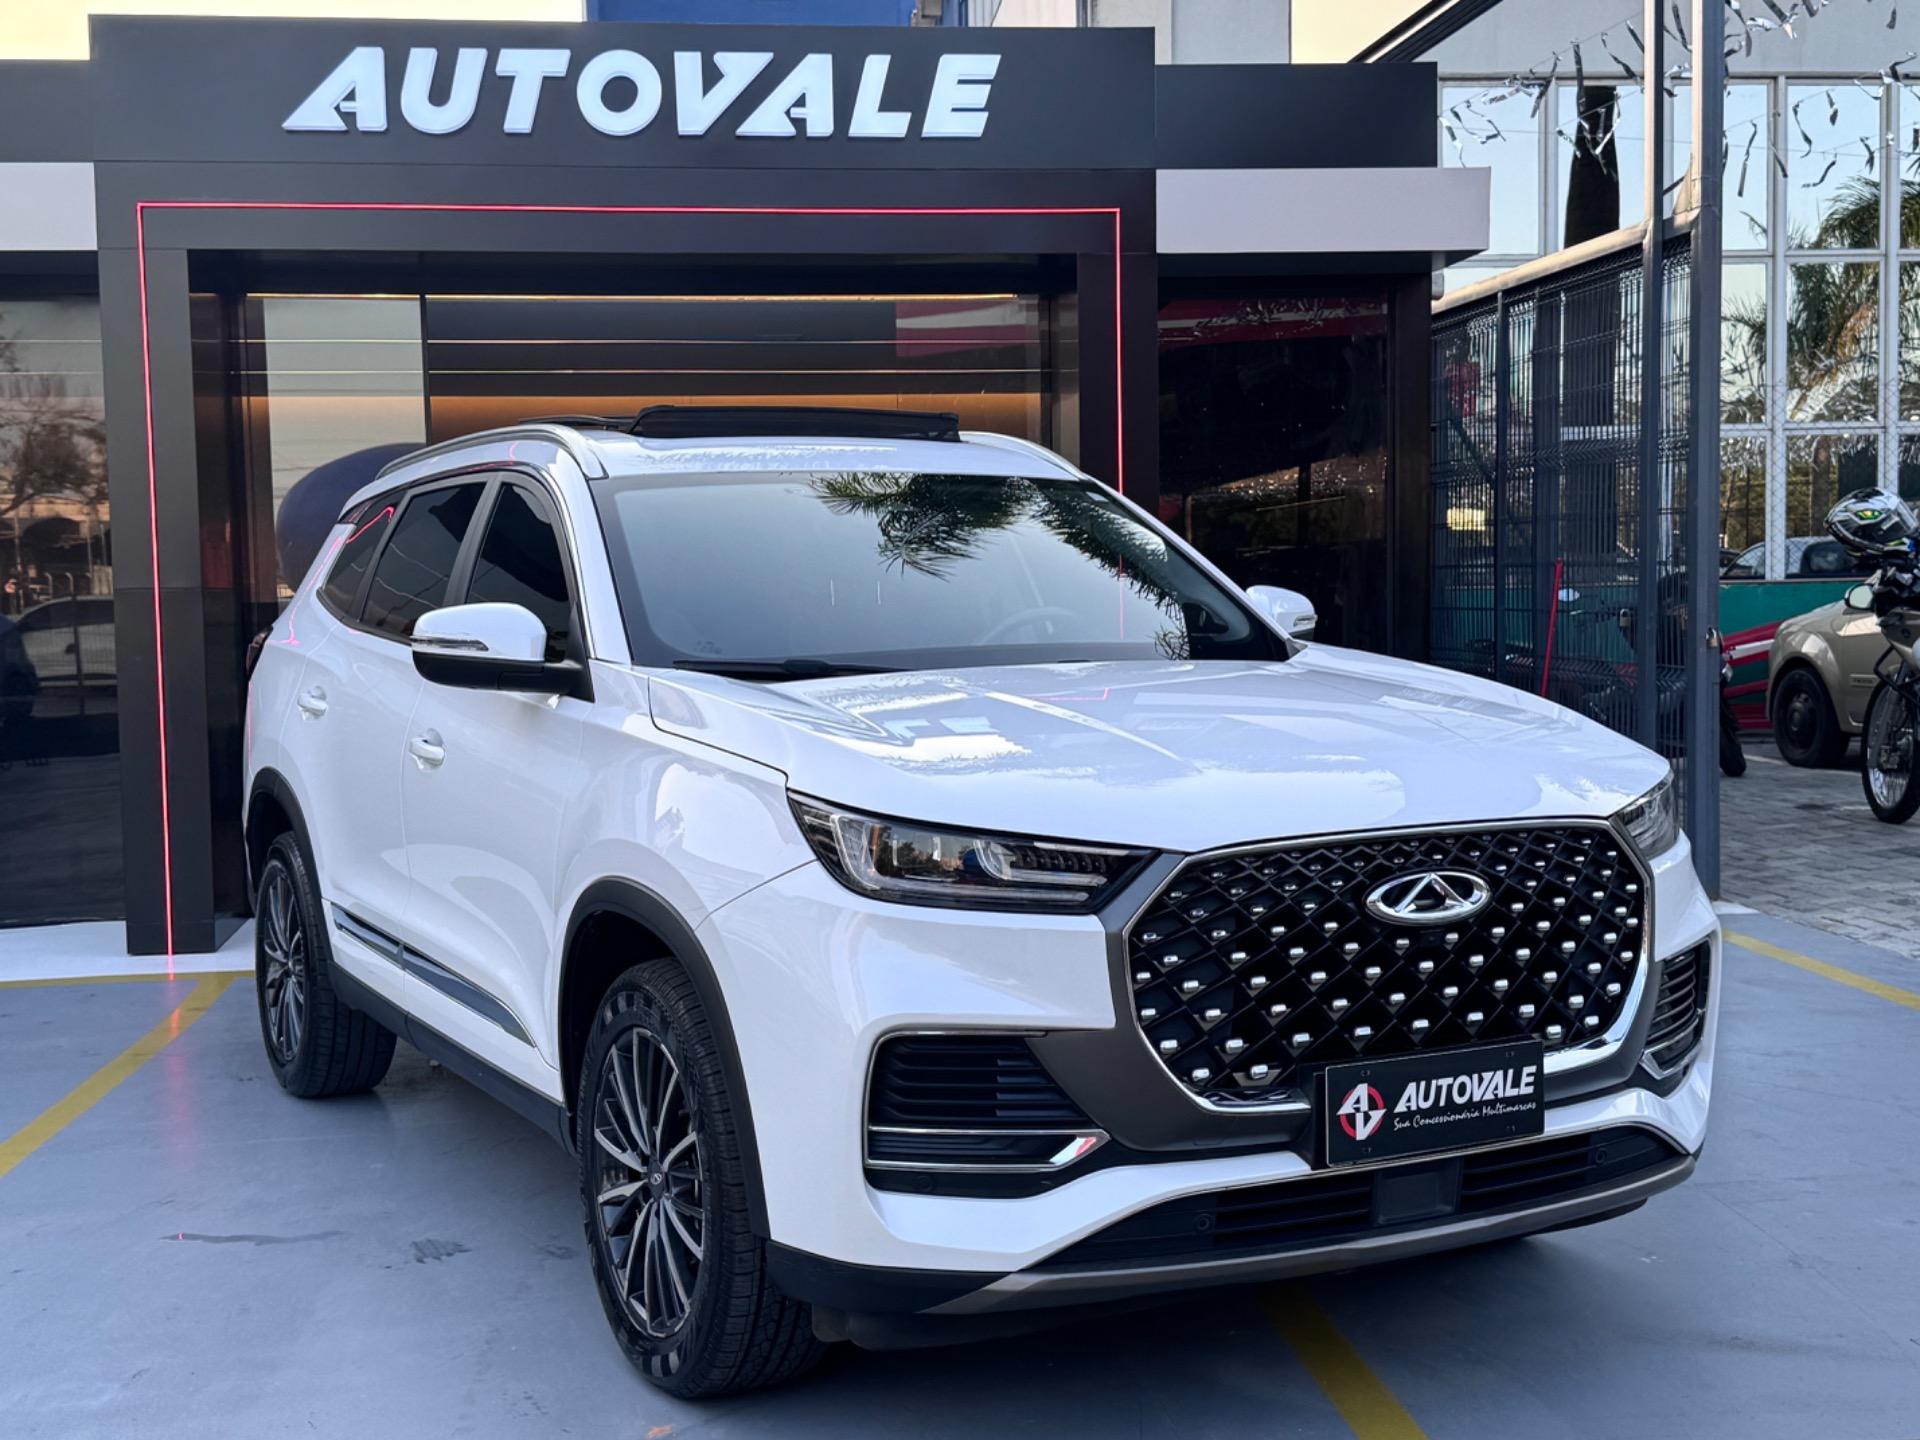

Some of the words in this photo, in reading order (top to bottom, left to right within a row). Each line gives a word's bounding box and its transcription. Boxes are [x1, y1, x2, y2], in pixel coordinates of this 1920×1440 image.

[282, 46, 1001, 138] AUTOVALE
[1393, 1065, 1537, 1113] AUTOVALE
[1393, 1118, 1411, 1131] Sua
[1482, 1101, 1536, 1117] Multimarcas
